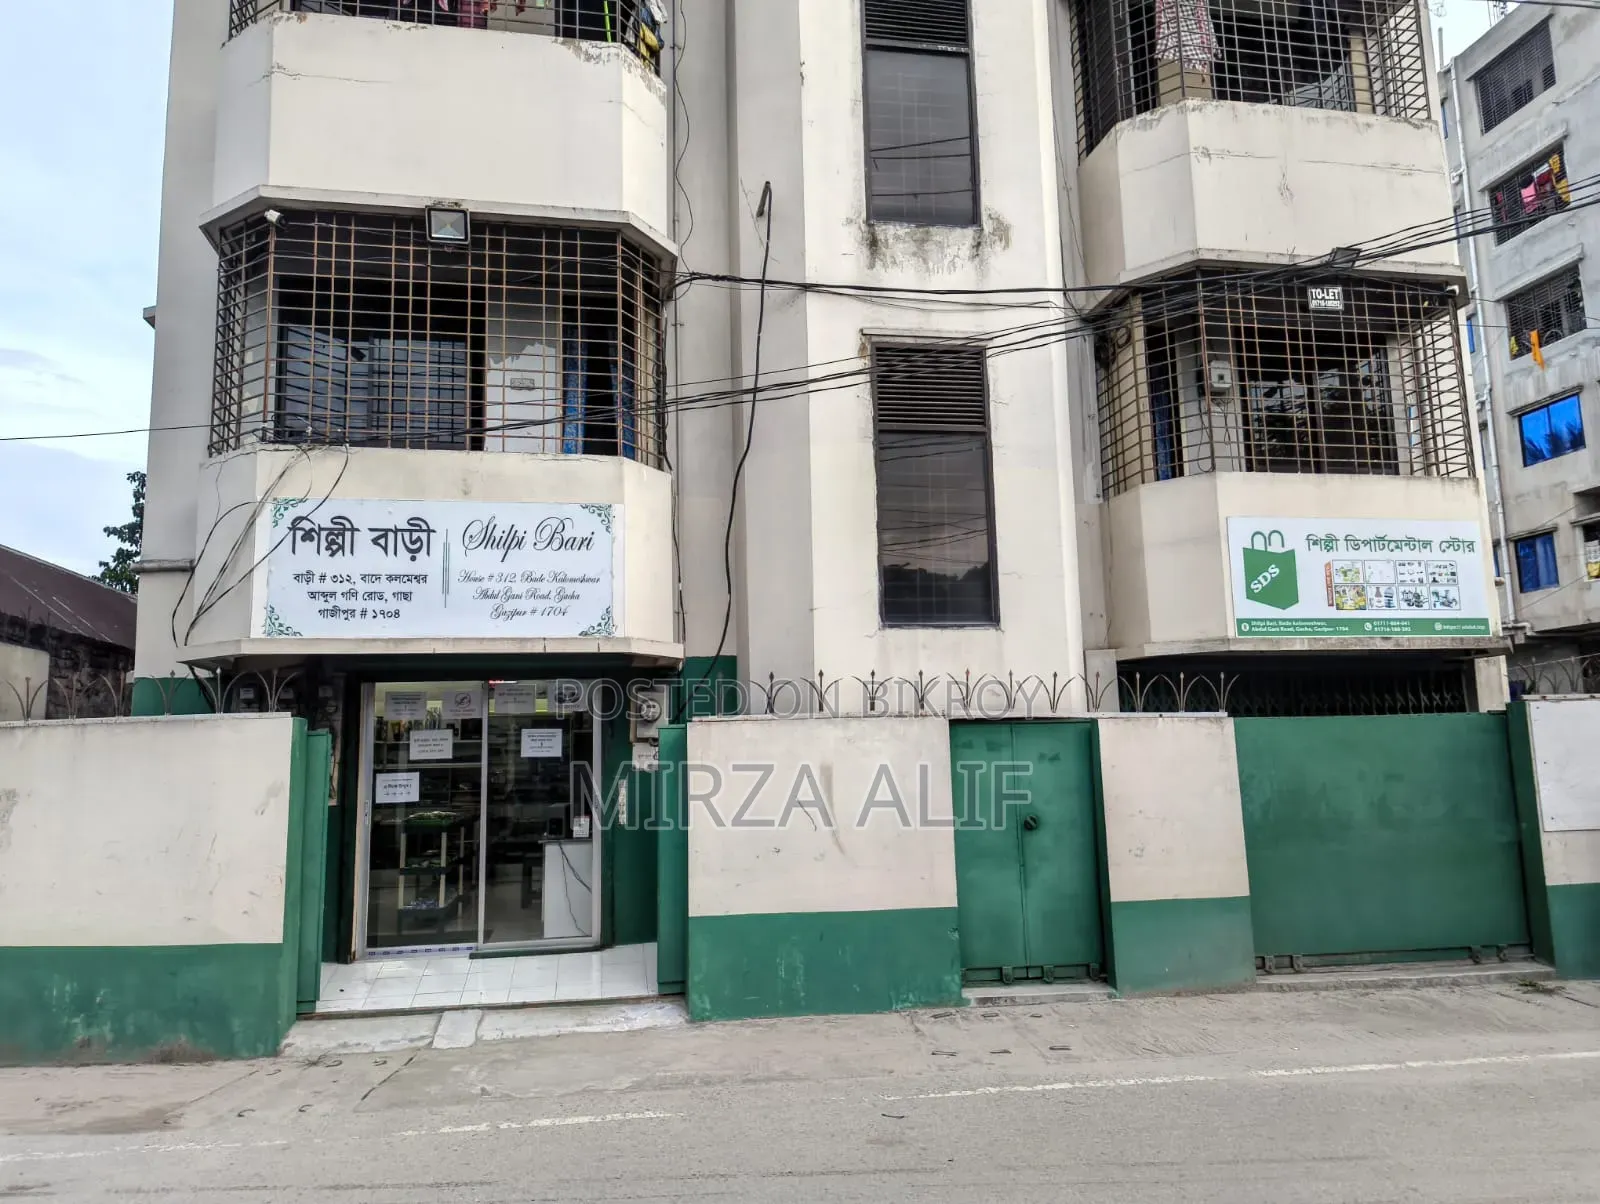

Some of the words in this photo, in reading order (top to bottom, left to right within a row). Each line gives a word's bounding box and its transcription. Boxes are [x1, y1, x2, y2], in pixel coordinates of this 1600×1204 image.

[1311, 288, 1339, 300] TO-LET
[287, 515, 361, 558] শিল্পী
[367, 516, 437, 562] বাড়ী
[461, 513, 527, 563] Shilpi
[532, 516, 595, 552] Bari
[1305, 533, 1341, 552] শিল্পী
[1343, 534, 1434, 553] ডিপার্টমেন্টাল
[1438, 536, 1477, 554] স্টোর
[292, 569, 316, 586] বাড়ী
[318, 573, 327, 584] #
[330, 574, 356, 586] ৩১২,
[359, 573, 382, 584] বাদে
[385, 573, 428, 585] কলমেশ্বর
[457, 569, 485, 584] House
[487, 572, 495, 583] #
[520, 569, 546, 584] Bade
[1250, 563, 1280, 594] SDS
[306, 591, 337, 603] আব্দুল
[340, 587, 358, 602] গণি
[362, 591, 389, 604] রোড,
[391, 591, 413, 602] গাছা
[472, 585, 500, 600] Abdul
[499, 585, 523, 603] Gani
[553, 585, 581, 603] Gacha
[317, 606, 357, 622] গাজীপুর
[360, 608, 368, 620] #
[371, 608, 401, 620] ১৭০৪
[489, 603, 528, 622] Gazipur
[529, 607, 538, 617] #
[540, 605, 571, 618] 1704
